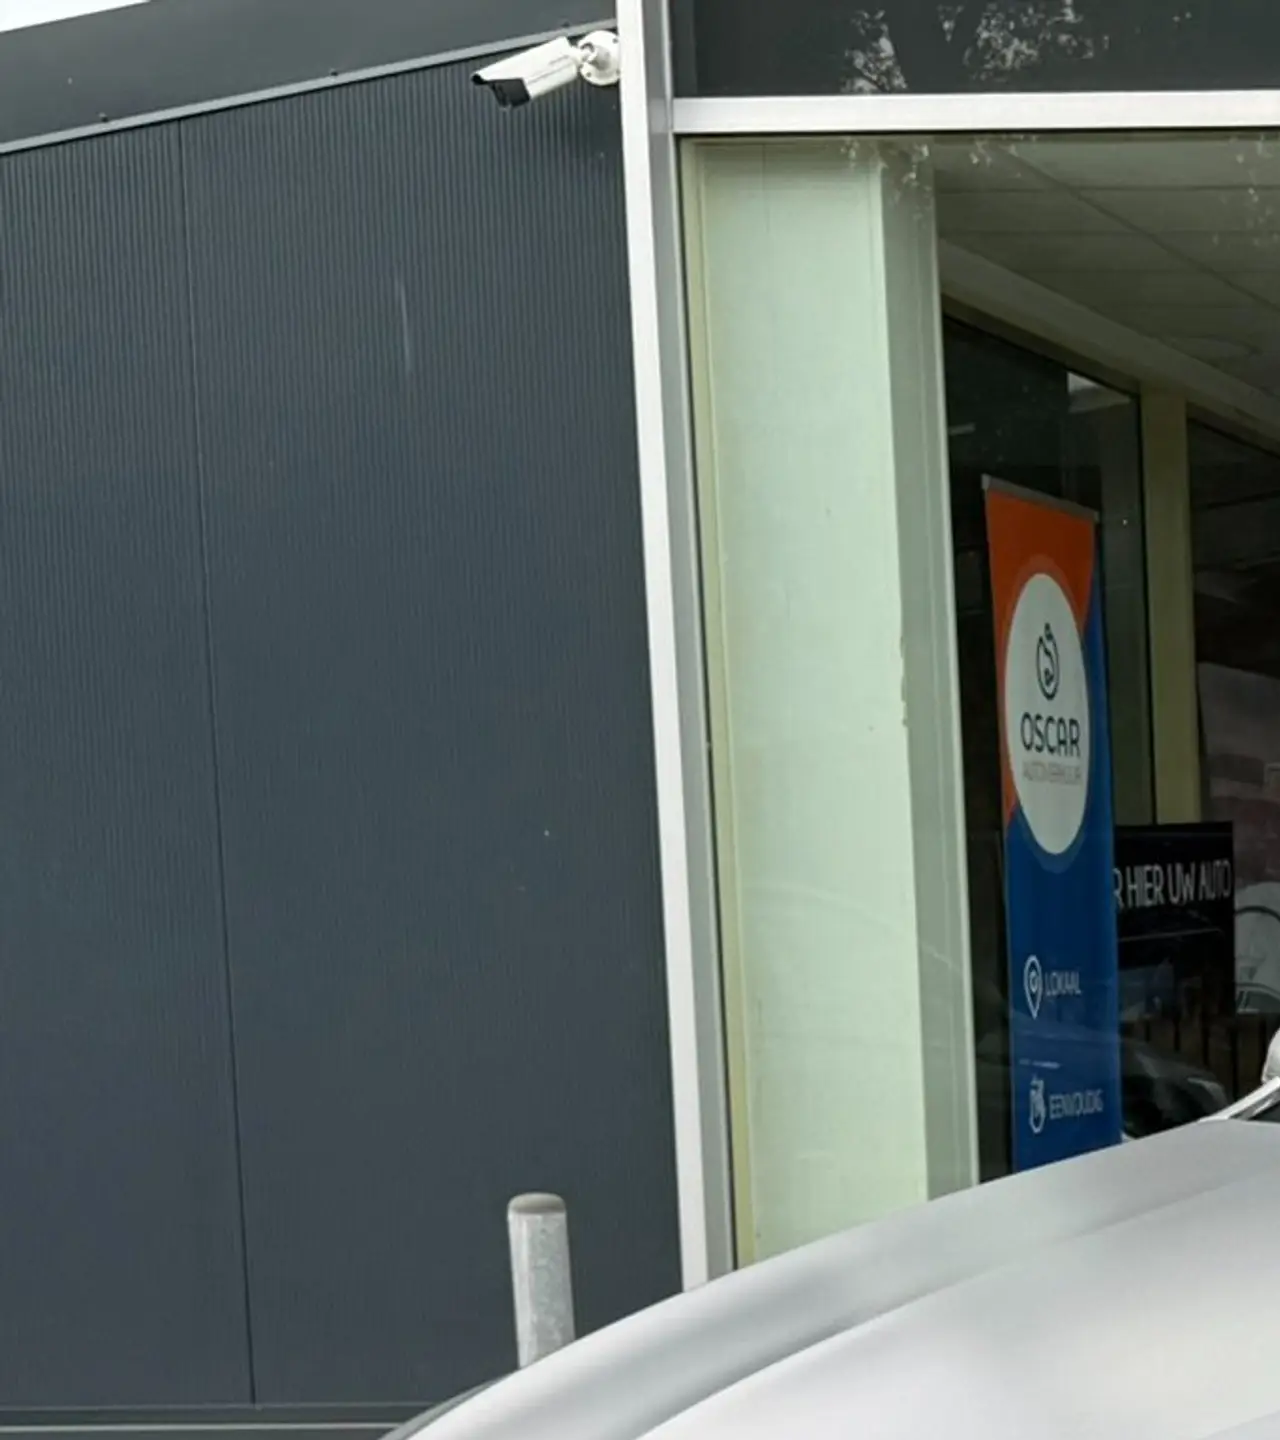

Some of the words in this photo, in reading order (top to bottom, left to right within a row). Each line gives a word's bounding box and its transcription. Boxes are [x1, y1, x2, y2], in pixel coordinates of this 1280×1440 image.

[1020, 711, 1081, 757] OSCAR
[1125, 863, 1165, 908] HIER
[1166, 861, 1195, 906] UW
[1199, 859, 1231, 901] AUTO
